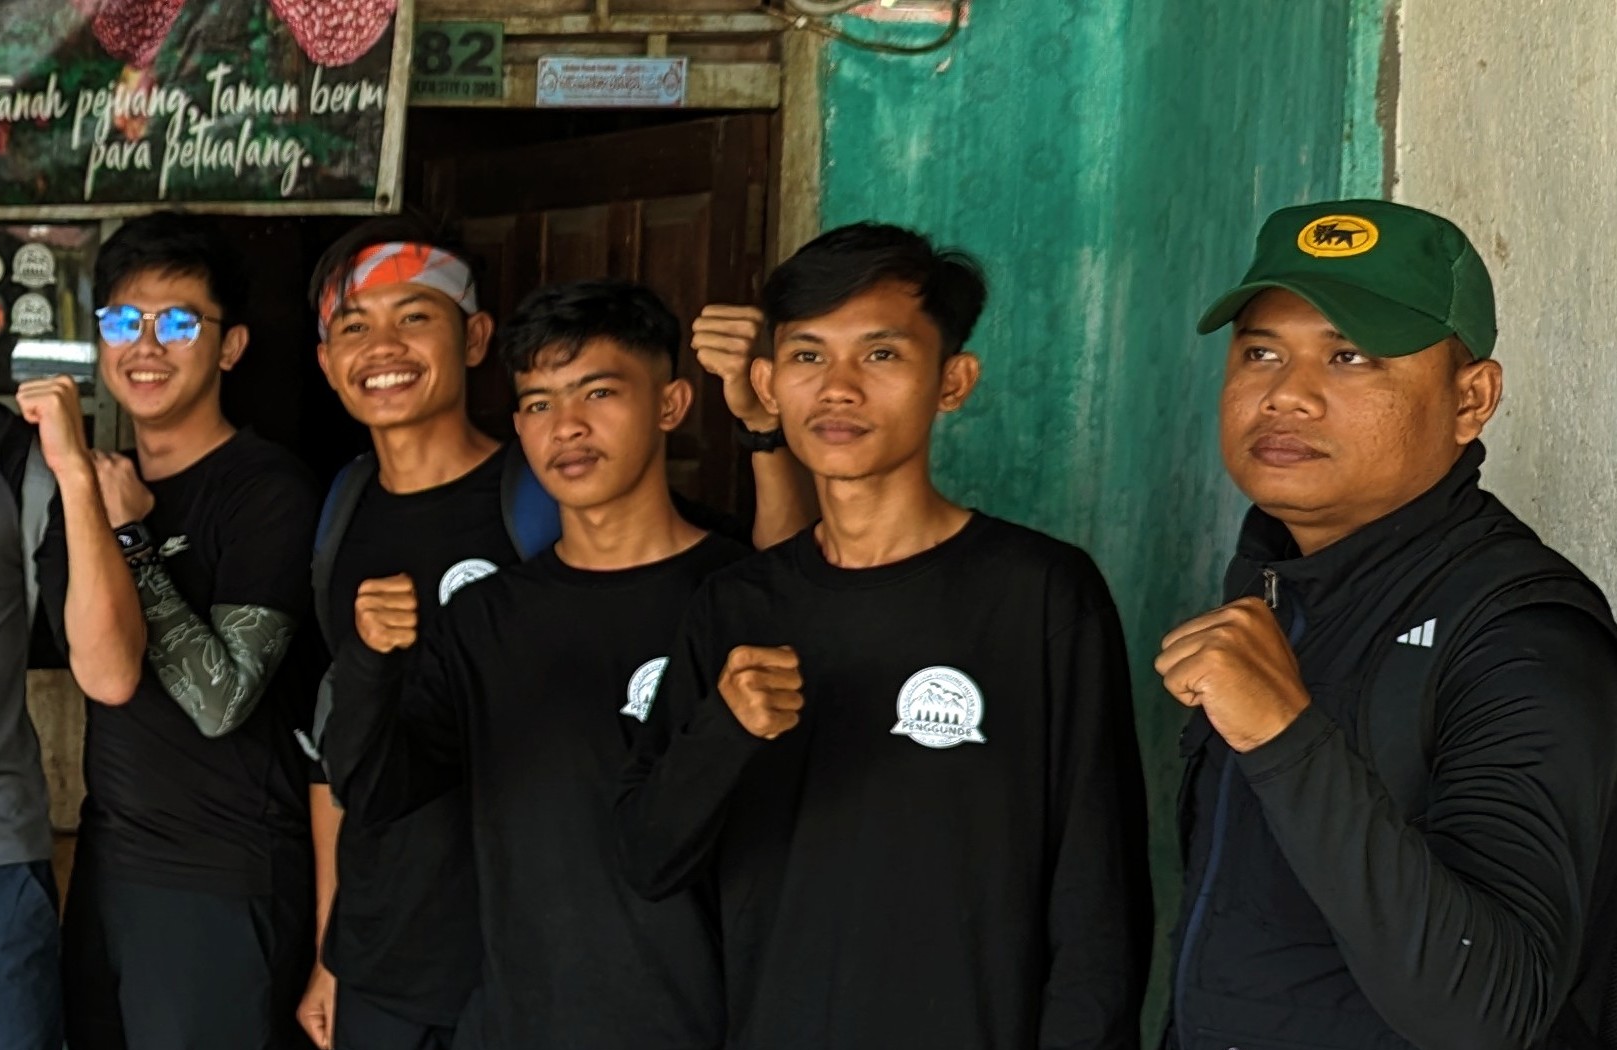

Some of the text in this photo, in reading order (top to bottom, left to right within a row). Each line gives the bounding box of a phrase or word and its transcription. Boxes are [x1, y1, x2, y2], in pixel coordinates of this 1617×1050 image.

[416, 30, 495, 77] 82
[84, 117, 314, 200] para petualang.
